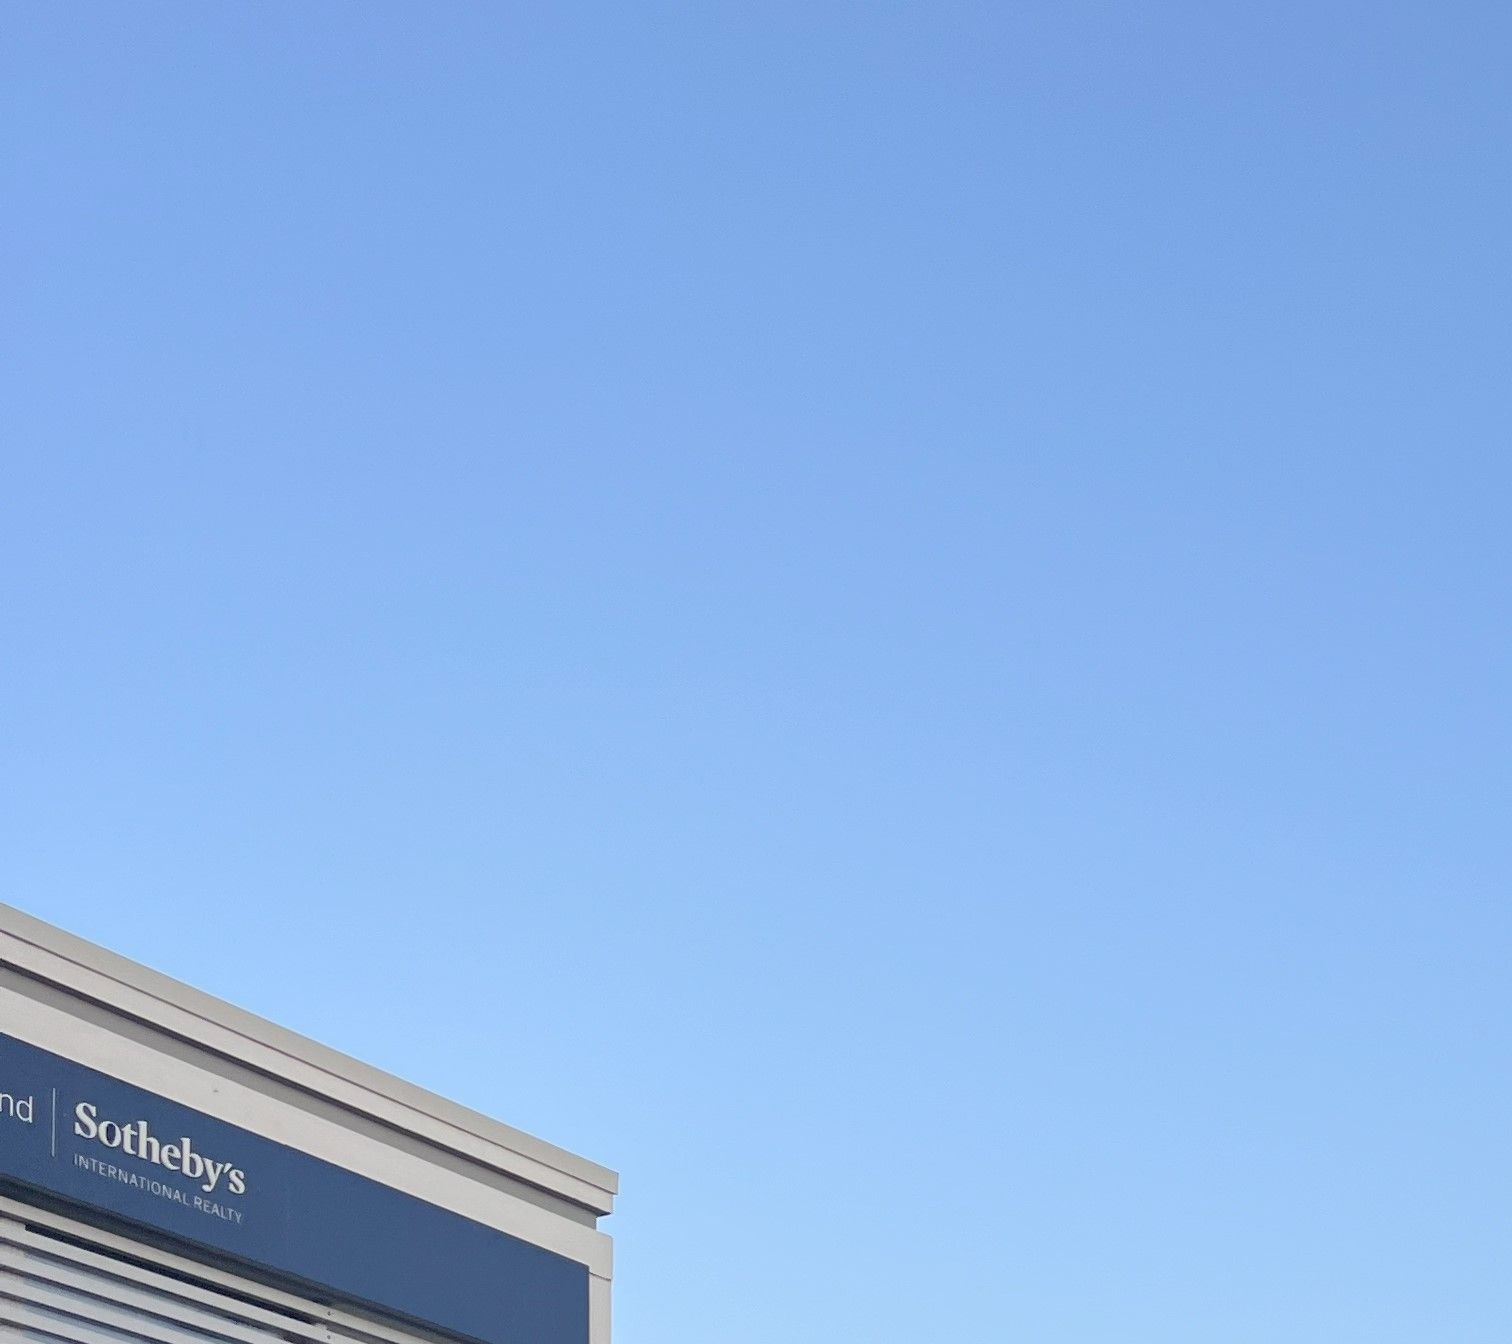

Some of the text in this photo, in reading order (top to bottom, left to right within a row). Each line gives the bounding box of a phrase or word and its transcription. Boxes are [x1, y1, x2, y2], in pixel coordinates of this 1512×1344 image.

[74, 1102, 246, 1194] Sotheby's
[74, 1153, 242, 1223] INTERNATIONAL REALTY
